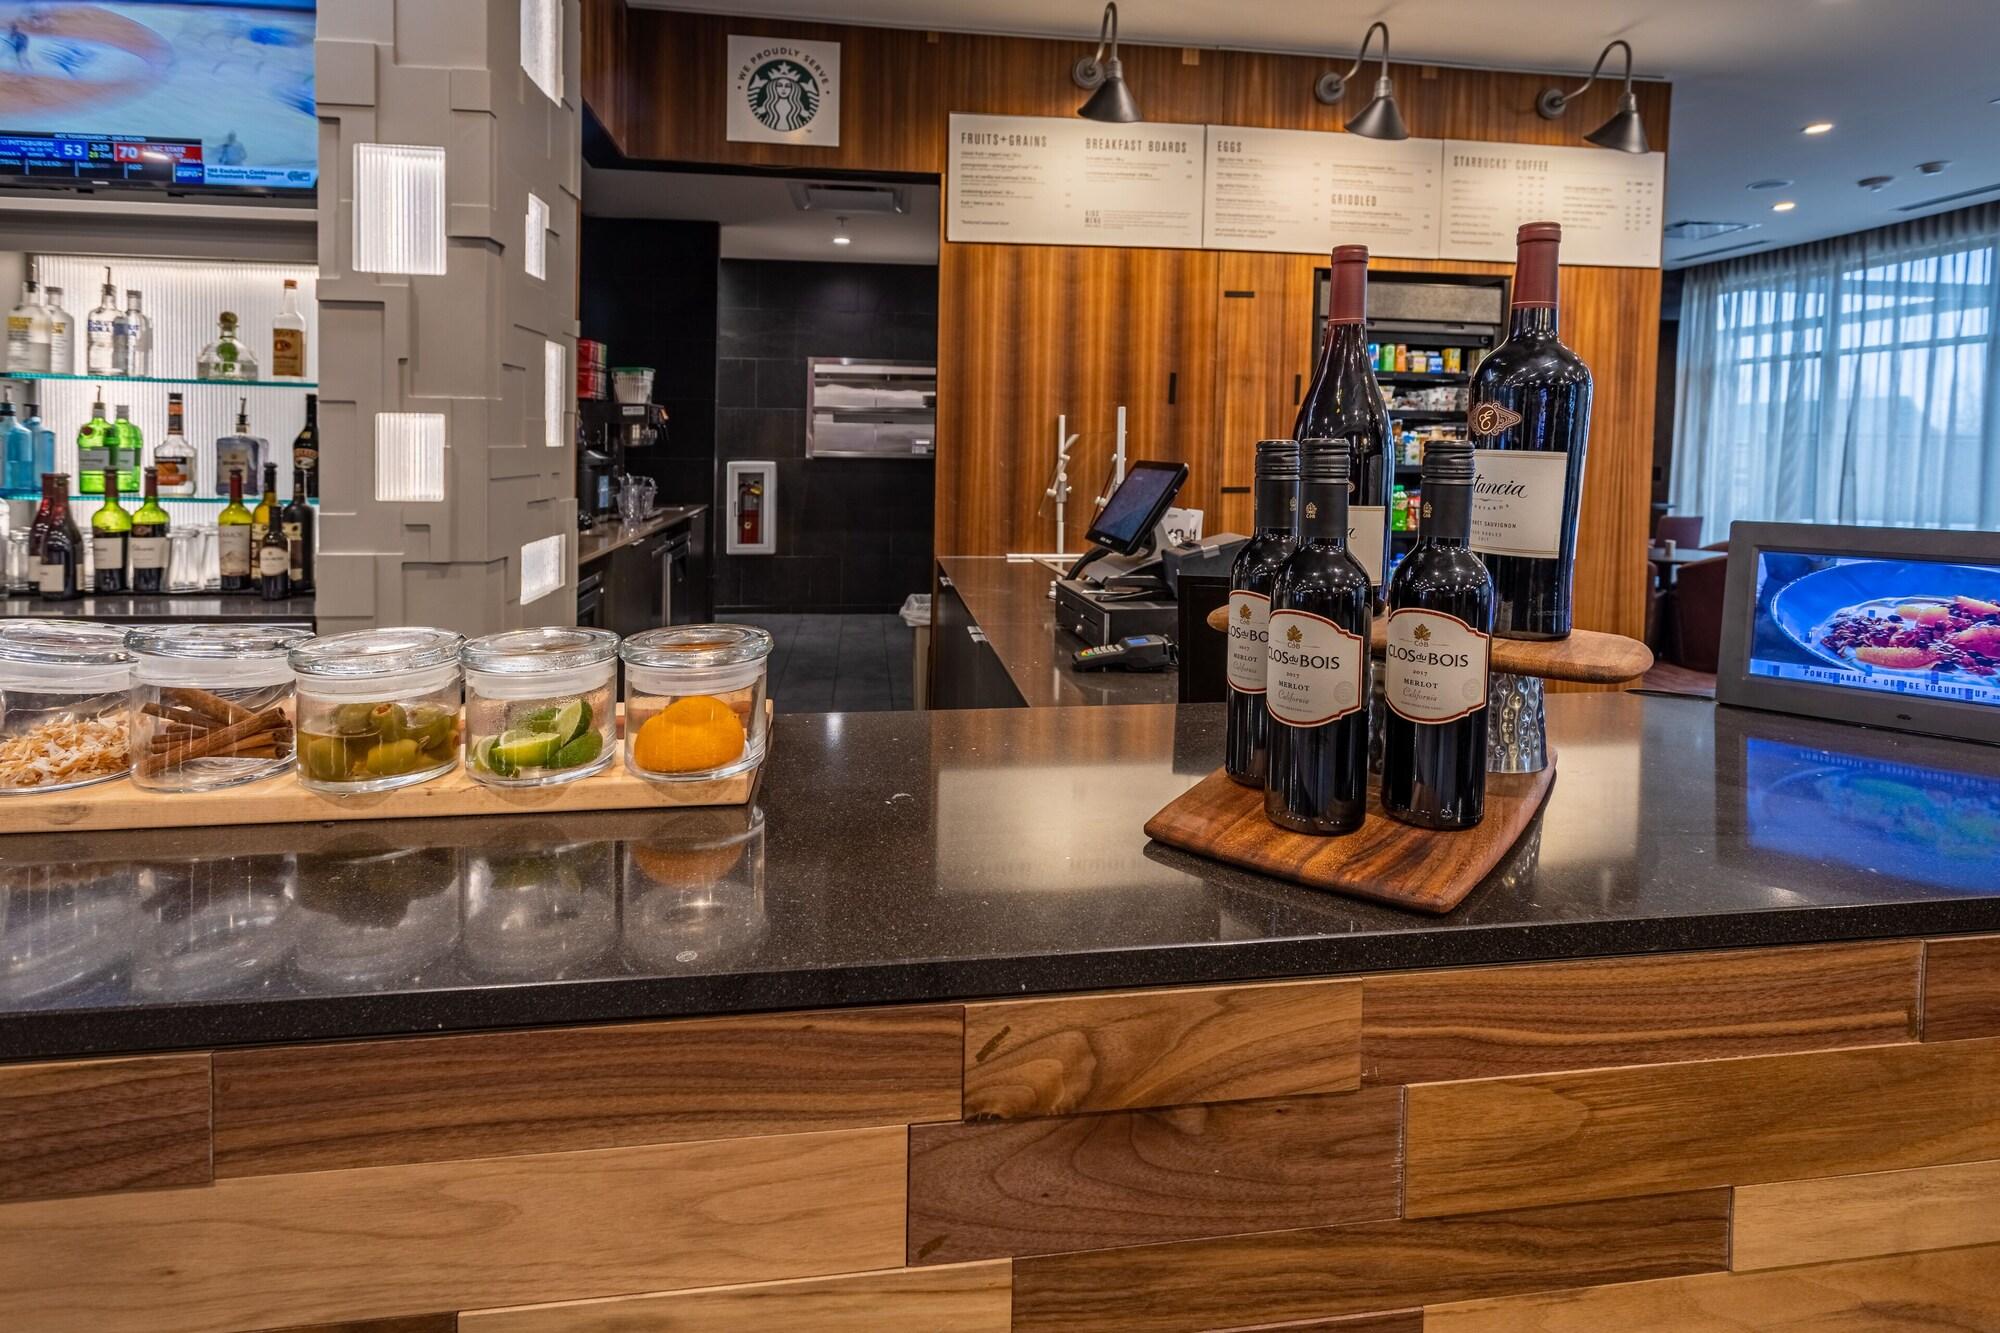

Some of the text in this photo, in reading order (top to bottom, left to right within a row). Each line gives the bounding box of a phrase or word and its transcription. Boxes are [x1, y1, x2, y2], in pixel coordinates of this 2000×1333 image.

[737, 47, 829, 85] WE PROUDLY SERVE
[63, 144, 83, 156] 53
[118, 146, 138, 159] 70
[1085, 138, 1187, 153] BREAKFAST BOARDS
[1217, 140, 1242, 153] EGGS
[1515, 159, 1549, 172] COFFEE
[1331, 193, 1378, 207] GRIDDLED
[1473, 473, 1528, 499] tancia
[1249, 630, 1269, 643] BO
[1233, 652, 1258, 663] MERLOT
[1289, 654, 1299, 665] du
[1300, 654, 1340, 670] BOIS
[1388, 643, 1469, 667] CLOS du BOIS
[1278, 679, 1311, 692] MERLOT
[1403, 677, 1439, 689] MERLOT
[1804, 669, 1868, 684] POMEGANATE
[1883, 679, 1920, 691] ORNGE
[1925, 684, 1962, 696] YOGURT
[1278, 690, 1310, 705] California
[1402, 686, 1438, 702] California
